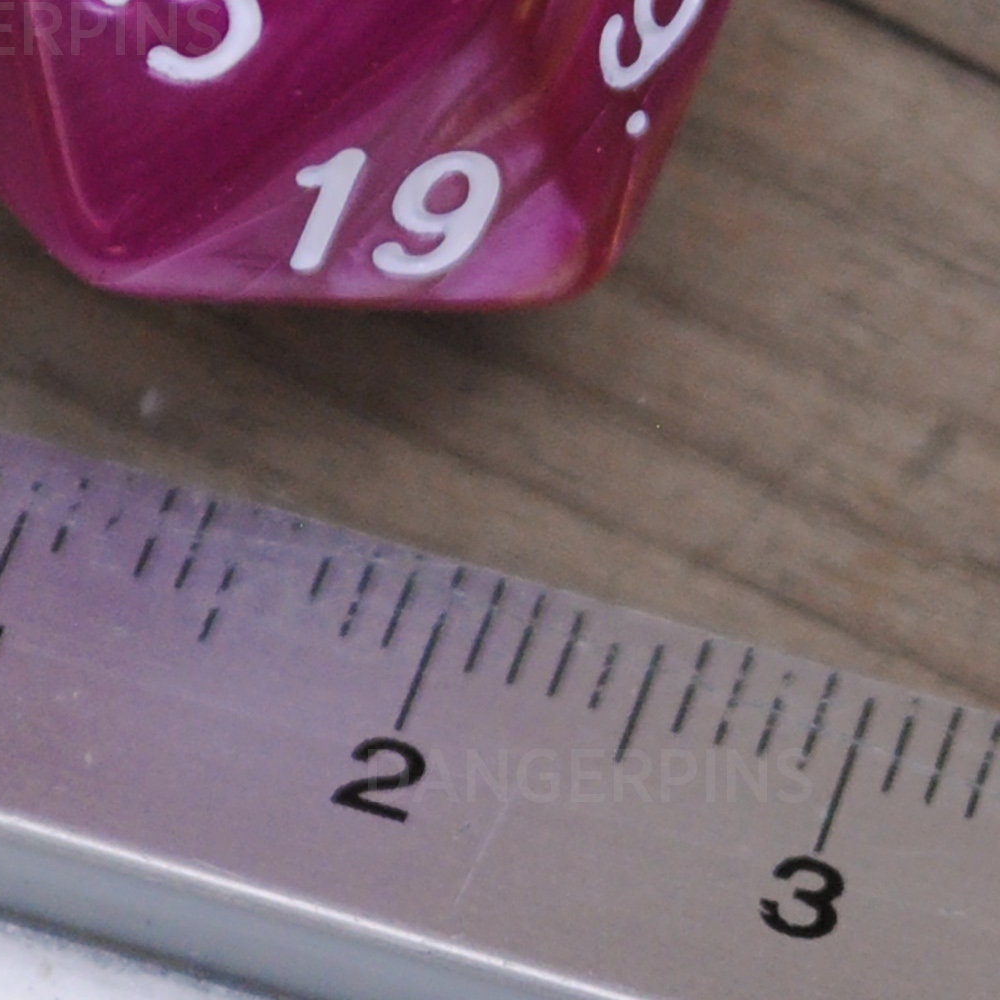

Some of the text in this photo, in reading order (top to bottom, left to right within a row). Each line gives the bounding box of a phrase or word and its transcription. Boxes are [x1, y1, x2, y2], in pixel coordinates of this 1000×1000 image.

[289, 147, 502, 280] 19
[330, 736, 427, 823] 2
[758, 854, 846, 939] 3
